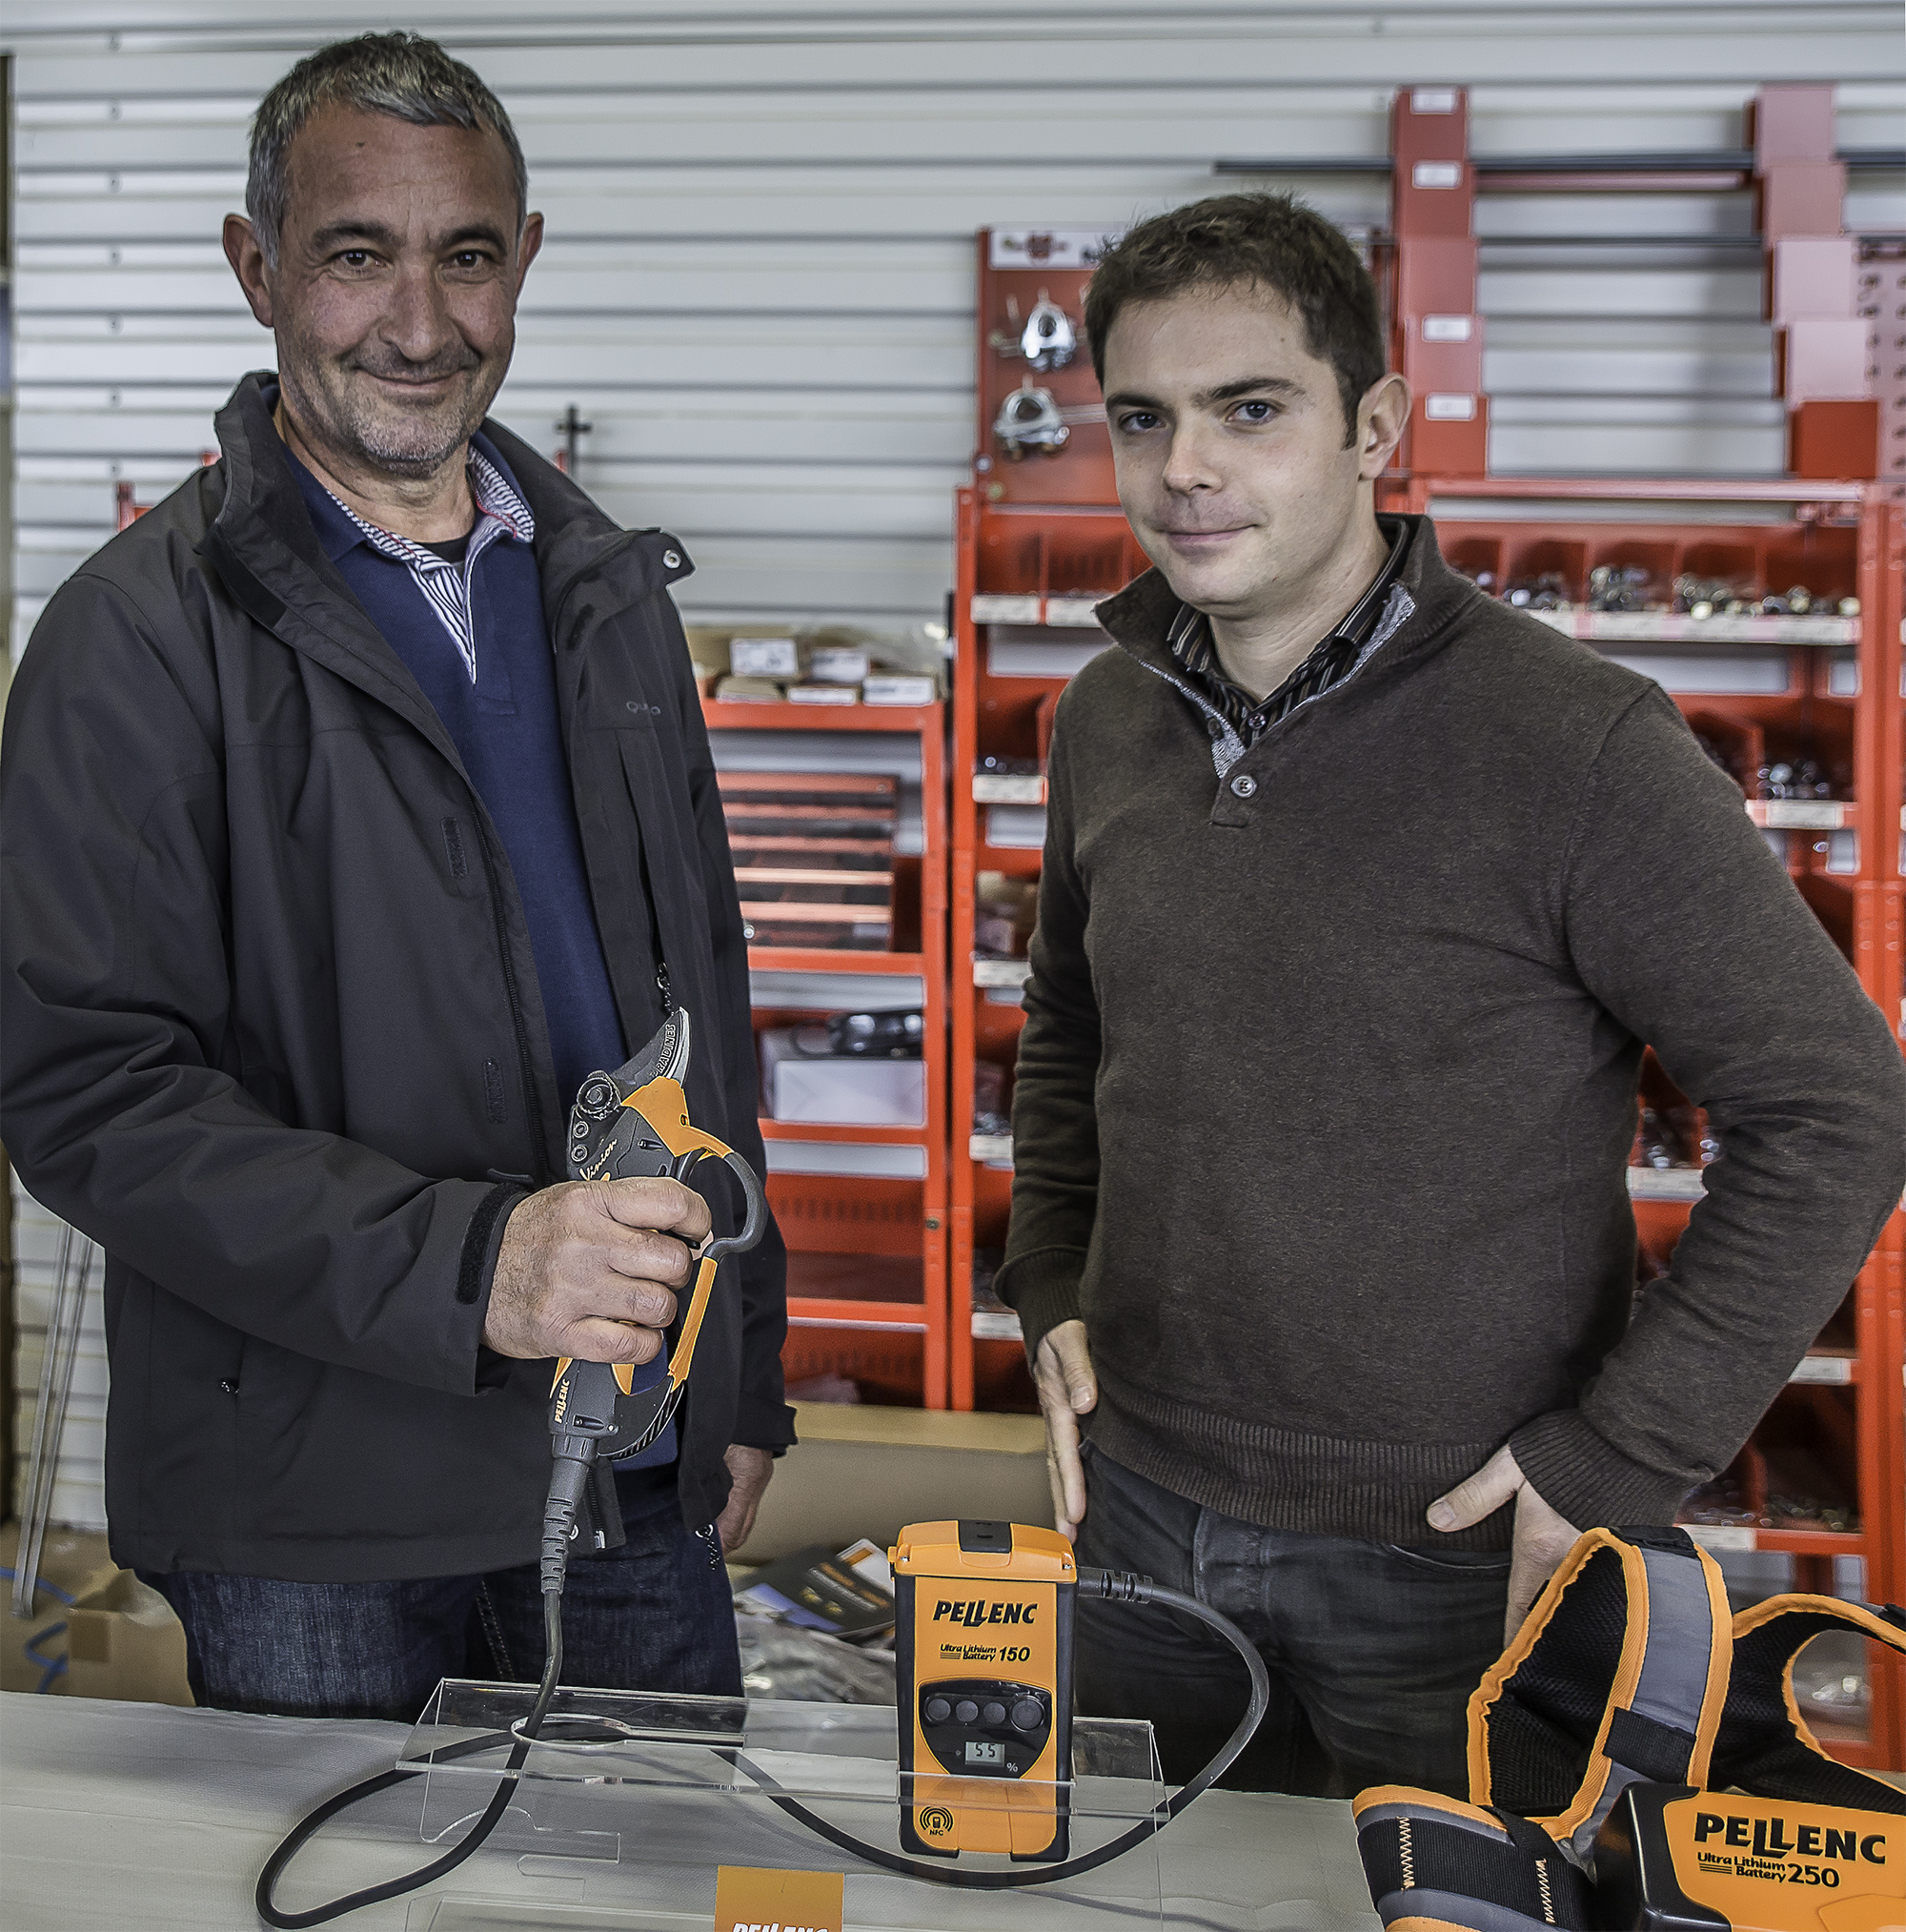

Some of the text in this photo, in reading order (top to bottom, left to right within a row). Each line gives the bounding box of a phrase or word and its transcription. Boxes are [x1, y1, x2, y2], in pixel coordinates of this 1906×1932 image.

[579, 1138, 618, 1181] Vinion
[554, 1378, 570, 1424] PELLENC
[933, 1599, 1038, 1627] PELLENC
[940, 1643, 997, 1654] Ultra Lithium
[963, 1646, 1031, 1662] Battery 150
[975, 1742, 996, 1758] 55
[1693, 1812, 1886, 1864] PELLENC
[1697, 1851, 1786, 1872] Ultra Lithium
[1735, 1862, 1840, 1888] Battery 250
